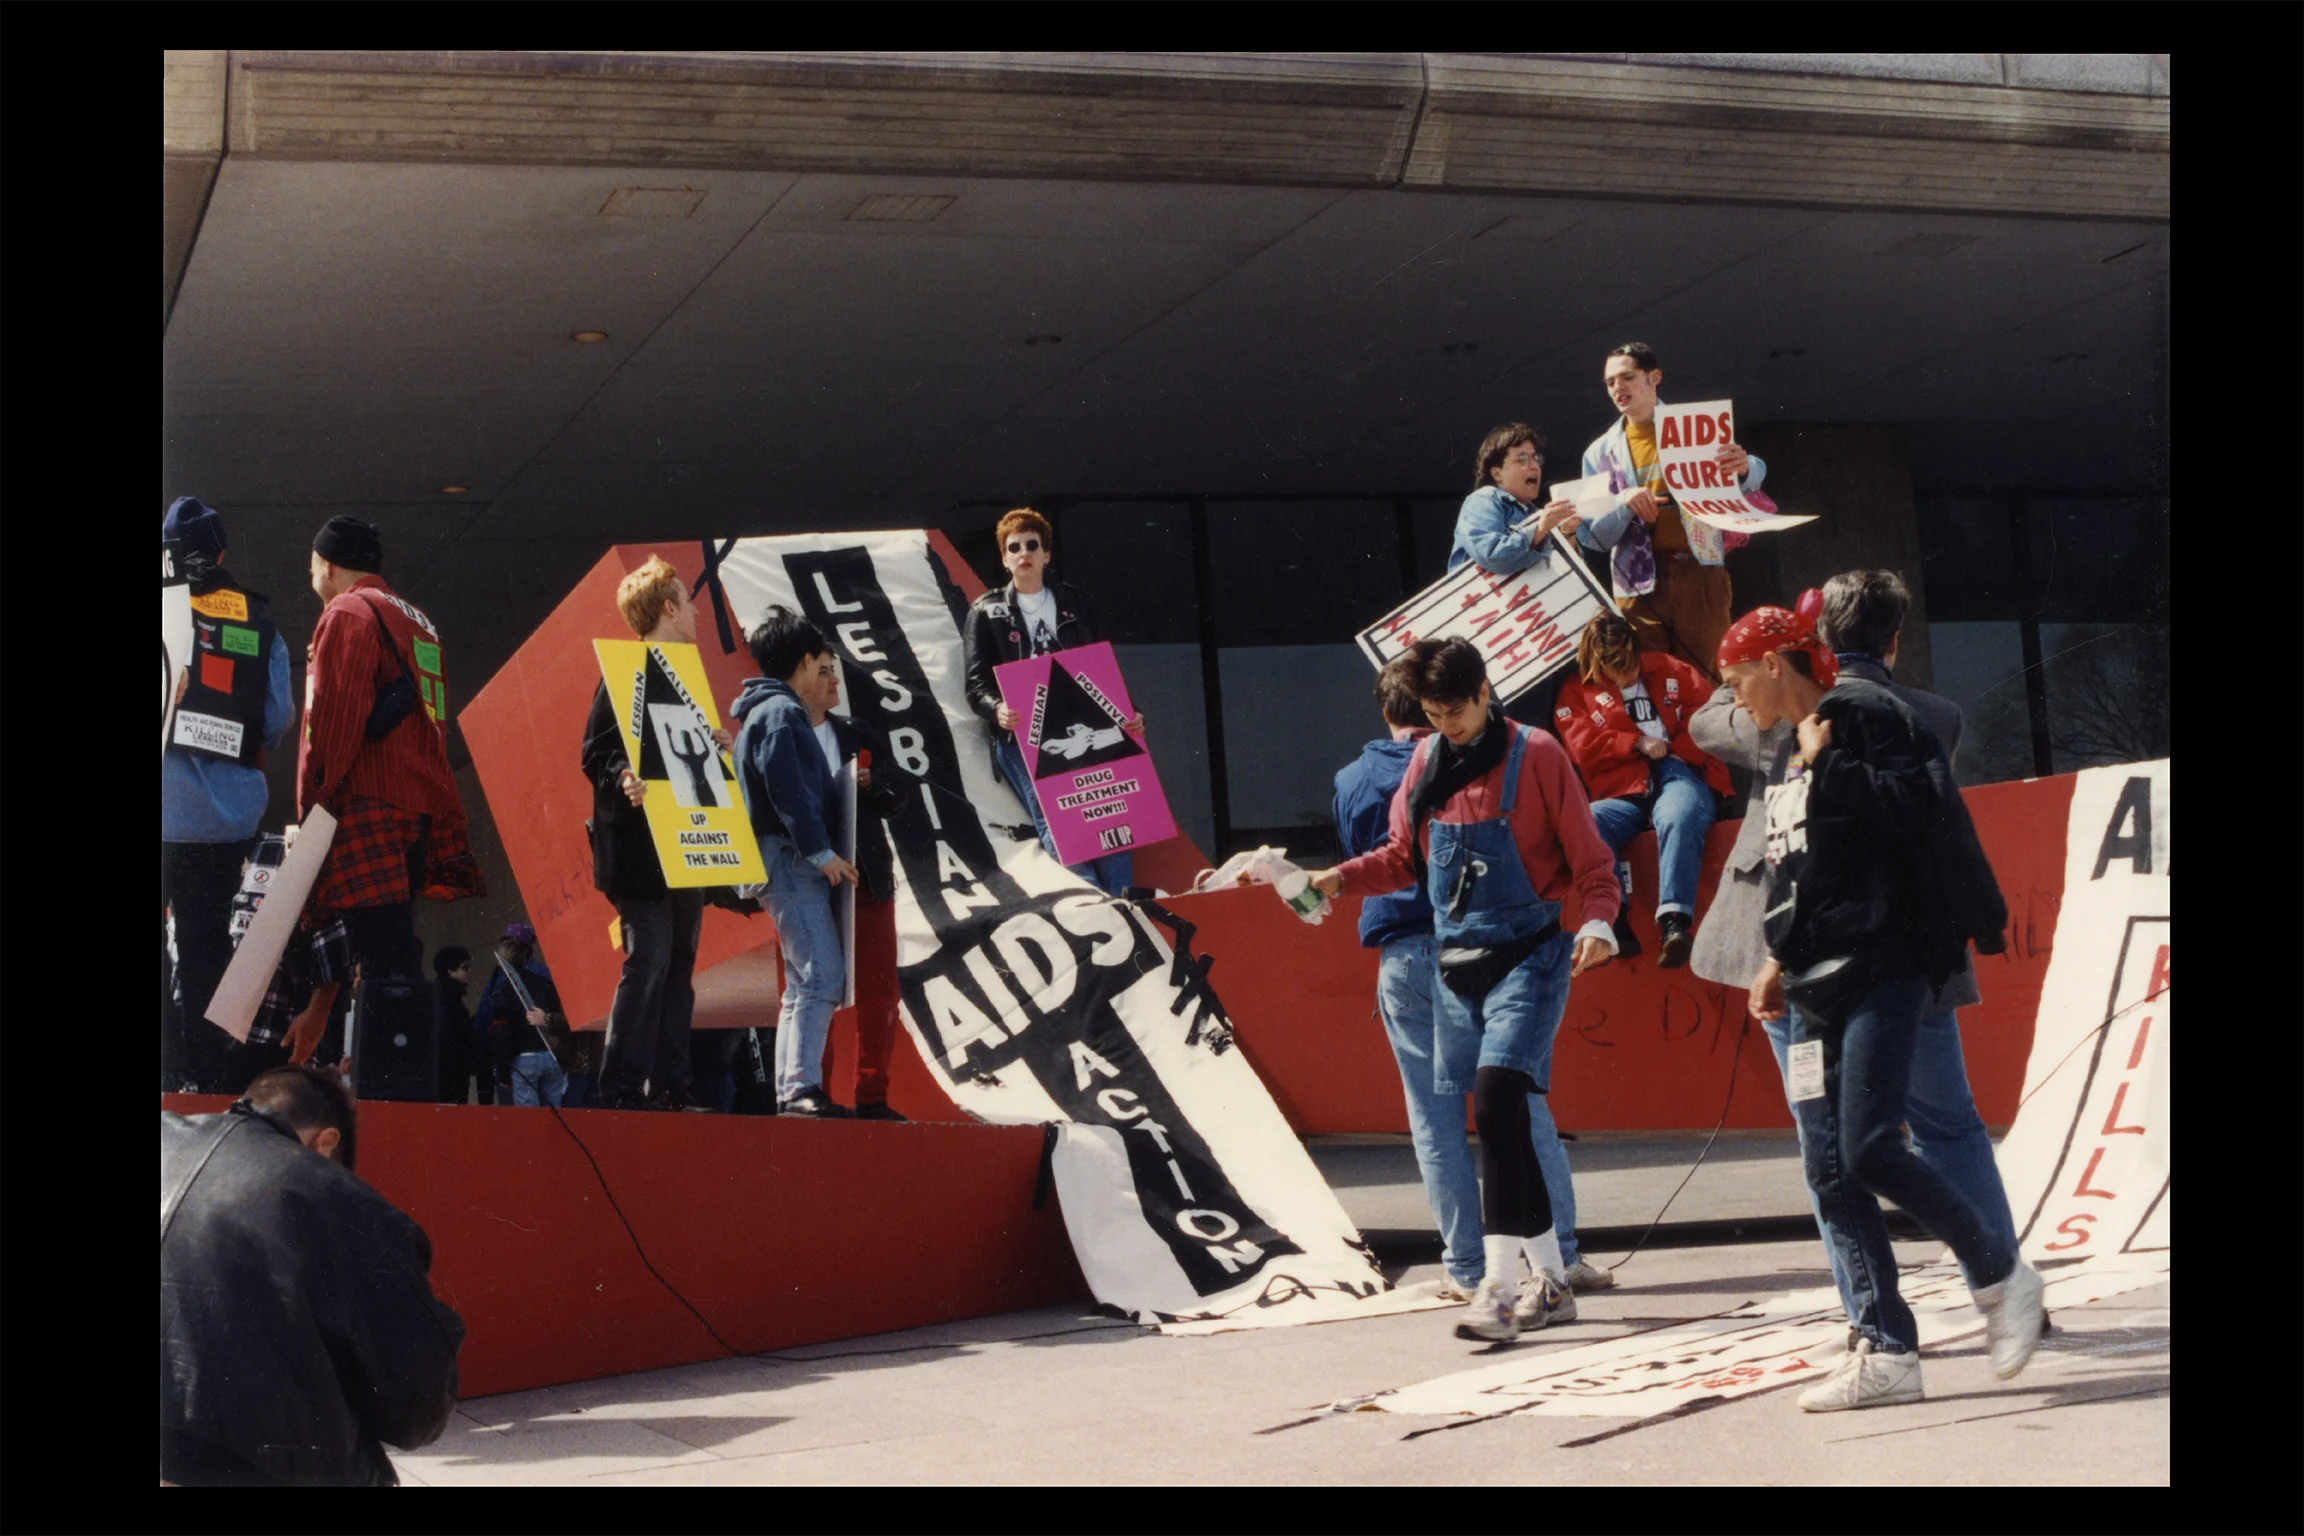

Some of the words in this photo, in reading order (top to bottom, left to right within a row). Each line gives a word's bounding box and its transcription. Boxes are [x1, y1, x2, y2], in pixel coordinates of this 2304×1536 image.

[1660, 412, 1732, 449] AIDS
[1665, 458, 1735, 490] CURE
[1681, 499, 1751, 516] NOW
[632, 671, 646, 738] LESBIAN
[653, 647, 697, 711] HEALTH
[1030, 685, 1048, 746] LESBIAN
[1076, 673, 1127, 727] POSITIVE
[1635, 699, 1652, 720] UP
[184, 724, 236, 742] KILLING
[812, 572, 1000, 921] LESBIAN
[1075, 770, 1113, 788] DRUG
[1058, 780, 1138, 808] TREATMENT
[690, 813, 707, 827] UP
[1083, 801, 1127, 820] NOW!!!
[680, 833, 729, 846] AGAINST
[1099, 826, 1119, 850] ACT
[1117, 825, 1132, 845] UP
[685, 854, 708, 867] THE
[709, 852, 740, 866] WALL
[923, 895, 1136, 1069] AIDS
[1067, 1040, 1266, 1273] ACTION
